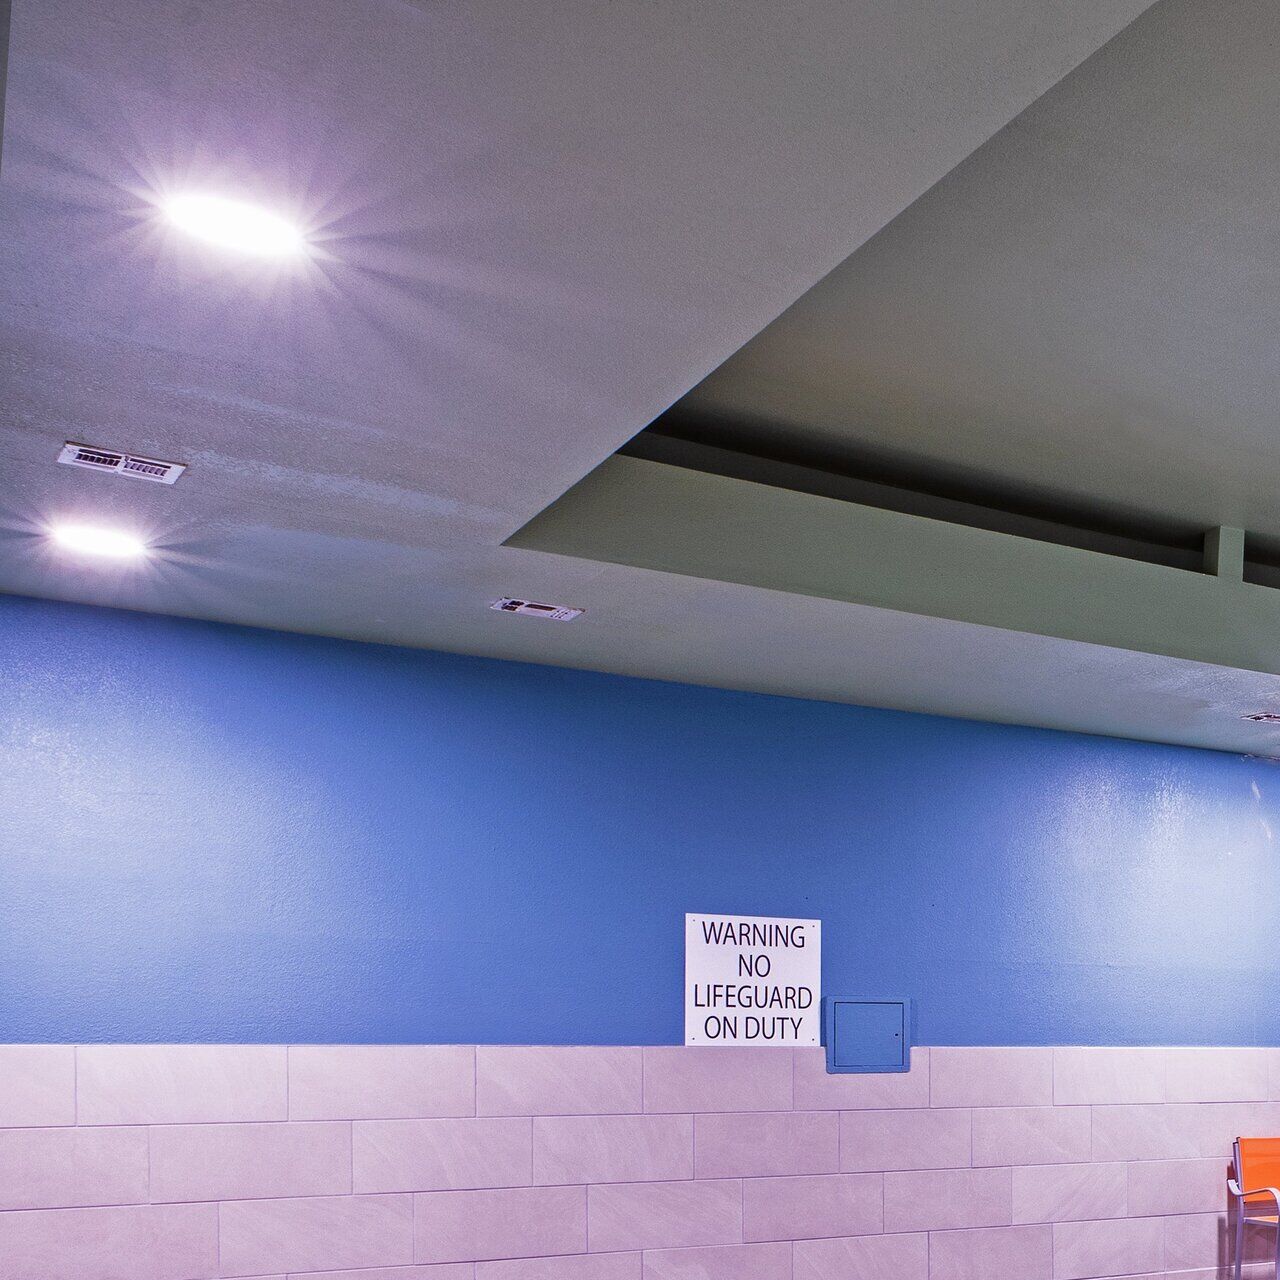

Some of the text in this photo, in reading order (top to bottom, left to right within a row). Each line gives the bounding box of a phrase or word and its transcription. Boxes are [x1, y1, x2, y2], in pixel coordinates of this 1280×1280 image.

[702, 921, 805, 948] WARNING
[738, 954, 771, 977] NO
[694, 984, 812, 1009] LIFEGUARD
[704, 1015, 803, 1040] ON DUTY
